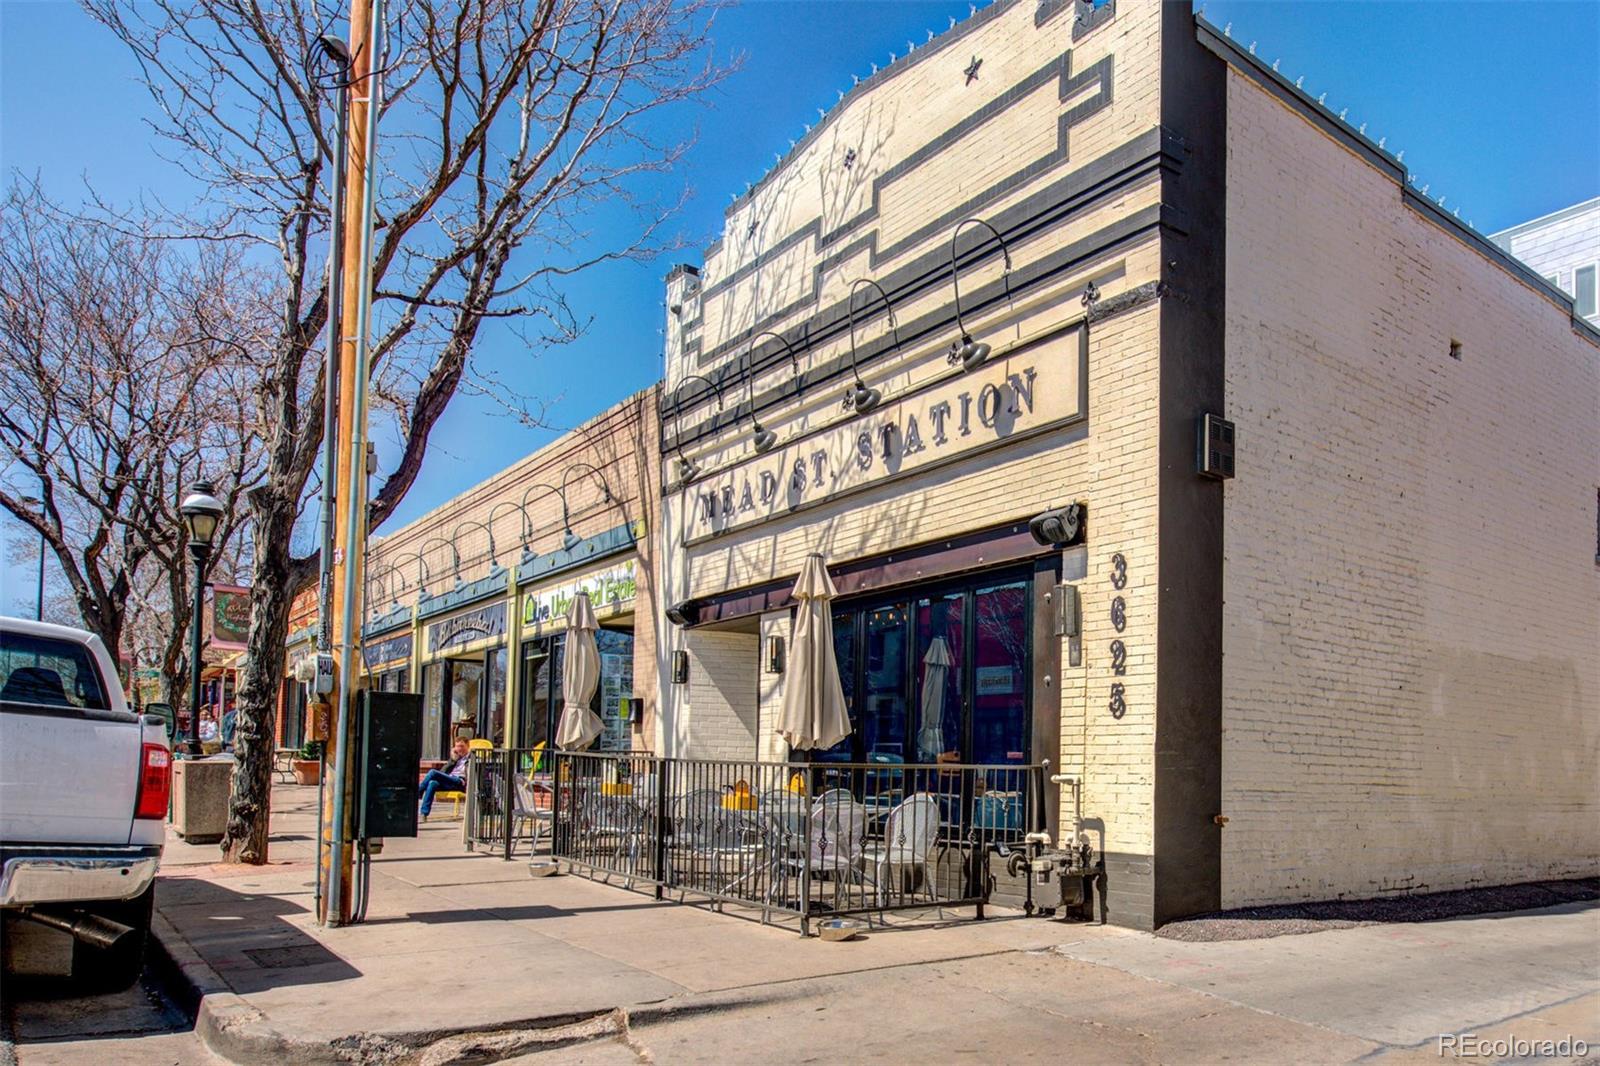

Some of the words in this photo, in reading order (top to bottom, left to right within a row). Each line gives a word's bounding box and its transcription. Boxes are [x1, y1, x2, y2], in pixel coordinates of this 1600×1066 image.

[699, 470, 776, 526] MEAD
[857, 366, 1038, 471] STATION
[1110, 553, 1126, 720] 3625
